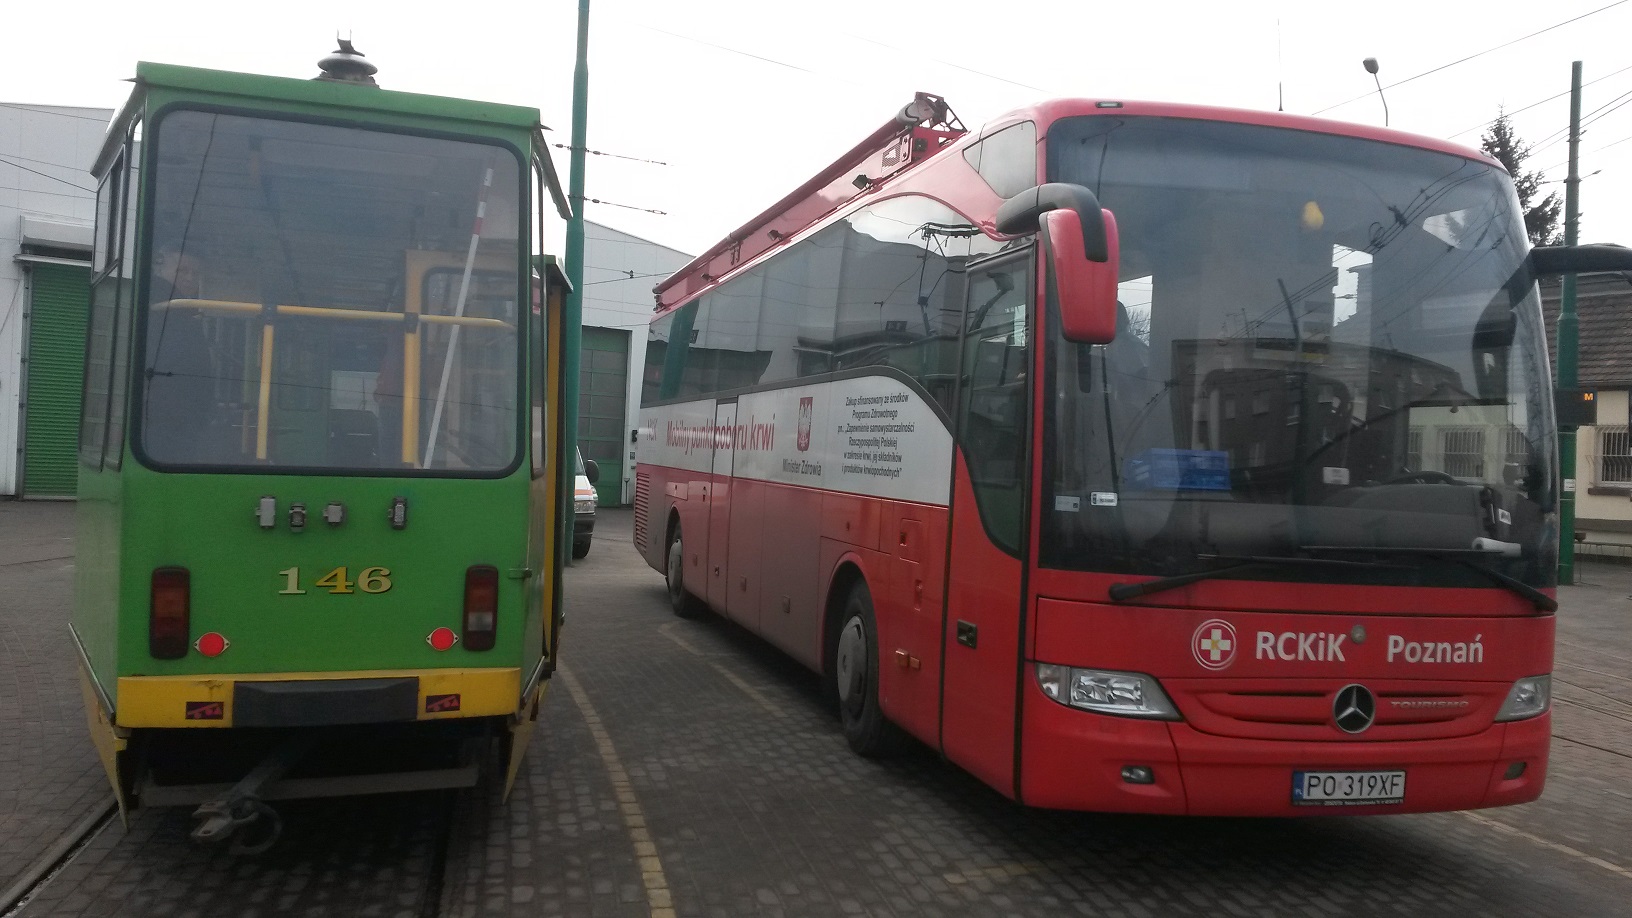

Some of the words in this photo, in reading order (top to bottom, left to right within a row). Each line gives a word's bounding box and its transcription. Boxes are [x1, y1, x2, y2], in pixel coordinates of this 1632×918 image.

[846, 396, 857, 407] Zakup
[857, 395, 884, 406] sfinansowany
[884, 395, 890, 404] ze
[890, 392, 909, 403] środków
[852, 409, 870, 421] Programu
[870, 408, 898, 420] Zdrowotnego
[666, 419, 691, 455] Mobilny
[690, 418, 714, 456] punkt
[713, 416, 748, 457] poboru
[750, 413, 776, 451] krwi
[870, 421, 915, 435] samowystarczalności
[849, 436, 880, 449] Rzeczypospolitej
[880, 436, 898, 450] Polskiej
[847, 450, 862, 460] zakresie
[878, 451, 902, 462] składników
[783, 458, 801, 473] Minister
[801, 459, 821, 476] Zdrowia
[844, 463, 863, 474] produktów
[278, 565, 393, 595] 146
[1255, 631, 1347, 662] RCKiK
[1387, 634, 1484, 663] Poznań
[1391, 701, 1469, 709] TOURISMO
[1307, 775, 1337, 797] PO
[1343, 774, 1403, 797] 319XF
